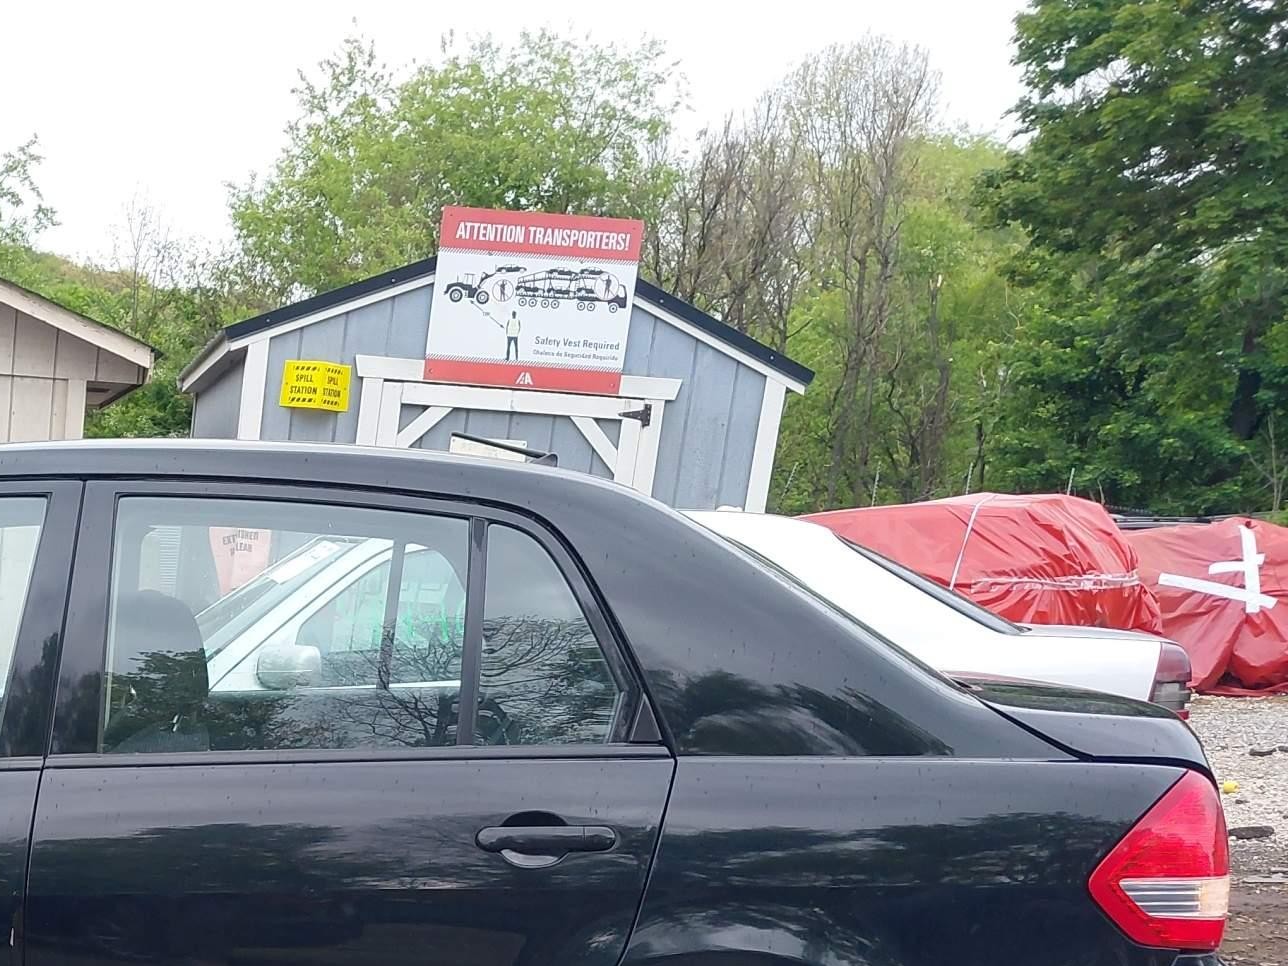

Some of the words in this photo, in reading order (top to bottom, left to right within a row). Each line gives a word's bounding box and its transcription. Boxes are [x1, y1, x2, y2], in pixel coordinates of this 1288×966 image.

[456, 221, 525, 243] ATTENTION
[528, 226, 631, 251] TRANSPORTERS!
[534, 336, 561, 347] Safety
[562, 338, 581, 348] Vest
[582, 339, 620, 351] Required
[295, 374, 314, 383] SPILL
[327, 376, 339, 386] SPILL
[289, 385, 318, 395] STATION
[323, 387, 341, 398] STATION
